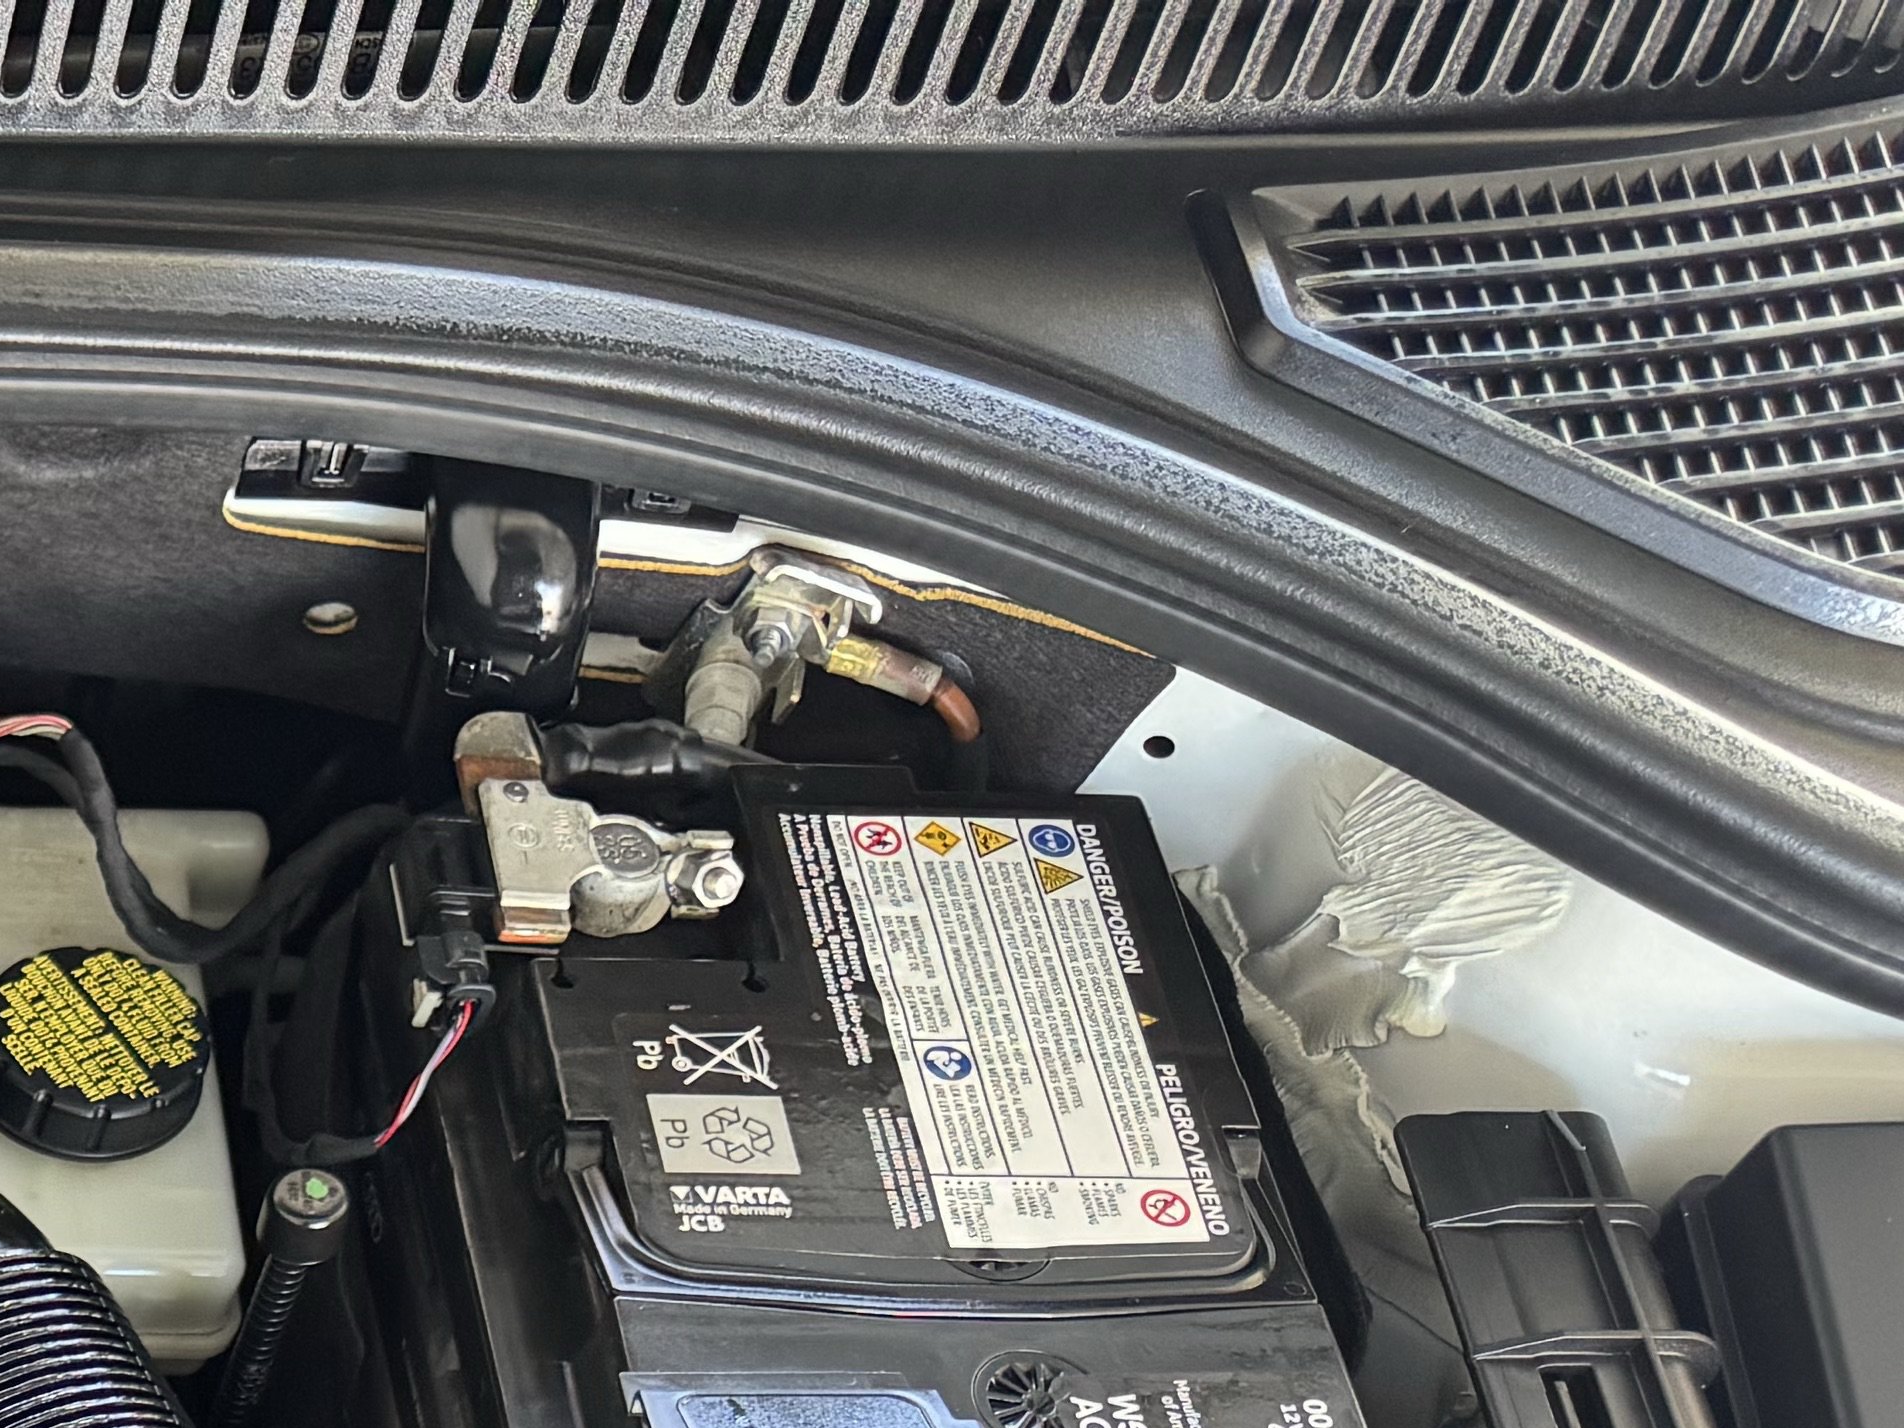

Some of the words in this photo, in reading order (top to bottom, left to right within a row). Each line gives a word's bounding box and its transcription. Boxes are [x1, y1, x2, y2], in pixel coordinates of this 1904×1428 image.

[794, 824, 817, 861] Prueba
[806, 863, 822, 876] de
[838, 976, 854, 990] de
[1075, 824, 1143, 973] DANGER/POISON
[826, 885, 854, 938] Lead-Acid
[841, 941, 867, 982] Battery
[82, 956, 112, 982] ONLY
[102, 981, 128, 1002] DOT
[151, 969, 196, 1016] WARNING:
[815, 949, 839, 994] Batterie
[21, 963, 66, 1009] BOUCHON
[56, 1007, 92, 1039] AVANT
[82, 1037, 104, 1054] DE
[93, 1051, 115, 1068] LE
[72, 967, 86, 977] A
[79, 975, 116, 1012] SEALED
[108, 1010, 160, 1066] CONTAINER.
[96, 951, 136, 990] BEFORE
[126, 987, 176, 1041] REMOVING.
[171, 1038, 196, 1061] USE
[120, 1000, 133, 1011] 4
[122, 958, 156, 990] CLEAN
[147, 988, 184, 1023] FILLER
[175, 1021, 200, 1041] CAP
[126, 1008, 158, 1038] FLUID
[0, 982, 38, 1022] LIQUIDE
[47, 1045, 104, 1101] PROVENANT
[13, 977, 39, 1002] SER.
[80, 1058, 106, 1081] QUE
[96, 1078, 119, 1096] DU
[33, 955, 104, 1033] AVERTISSEMENT:
[98, 1033, 147, 1083] NETTOYER
[138, 1081, 159, 1097] LE
[18, 1031, 73, 1087] CONTENANT
[149, 1037, 182, 1067] FROM
[633, 1041, 664, 1070] Pb
[660, 1118, 690, 1148] Pb
[1154, 1063, 1231, 1236] PELIGRO/VENENO
[674, 1203, 711, 1214] Made
[714, 1204, 728, 1214] in
[730, 1204, 792, 1218] Germany
[694, 1186, 790, 1204] VARTA
[678, 1216, 725, 1232] JCB
[1160, 1395, 1179, 1409] of
